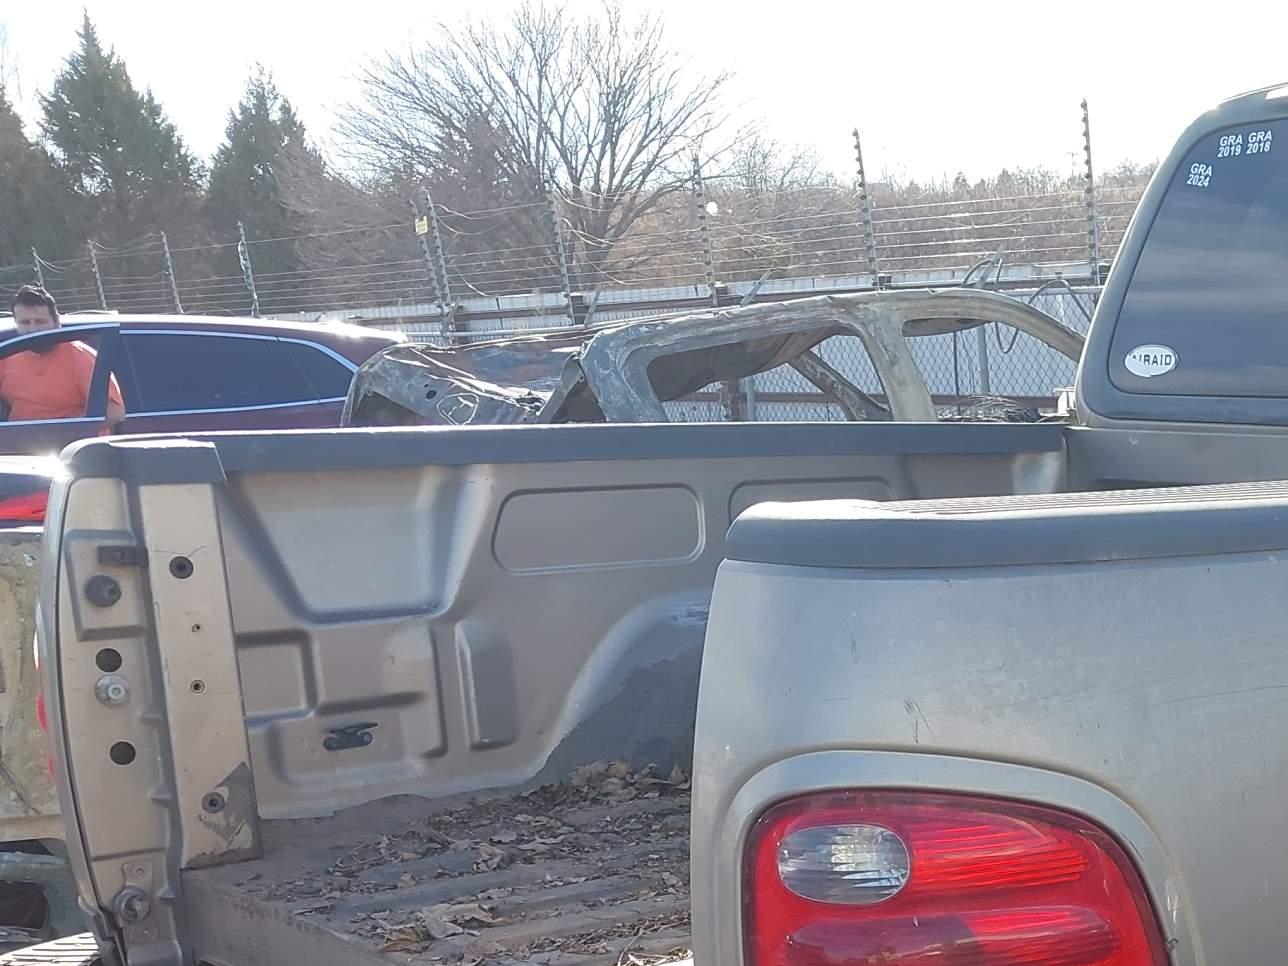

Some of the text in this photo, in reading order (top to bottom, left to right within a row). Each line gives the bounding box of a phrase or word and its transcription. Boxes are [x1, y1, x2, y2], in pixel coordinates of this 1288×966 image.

[1219, 133, 1243, 147] GRA
[1248, 130, 1272, 143] GRA
[1217, 144, 1242, 158] 2019
[1246, 141, 1271, 155] 2018
[1190, 163, 1212, 177] GRA
[1186, 173, 1210, 188] 2024
